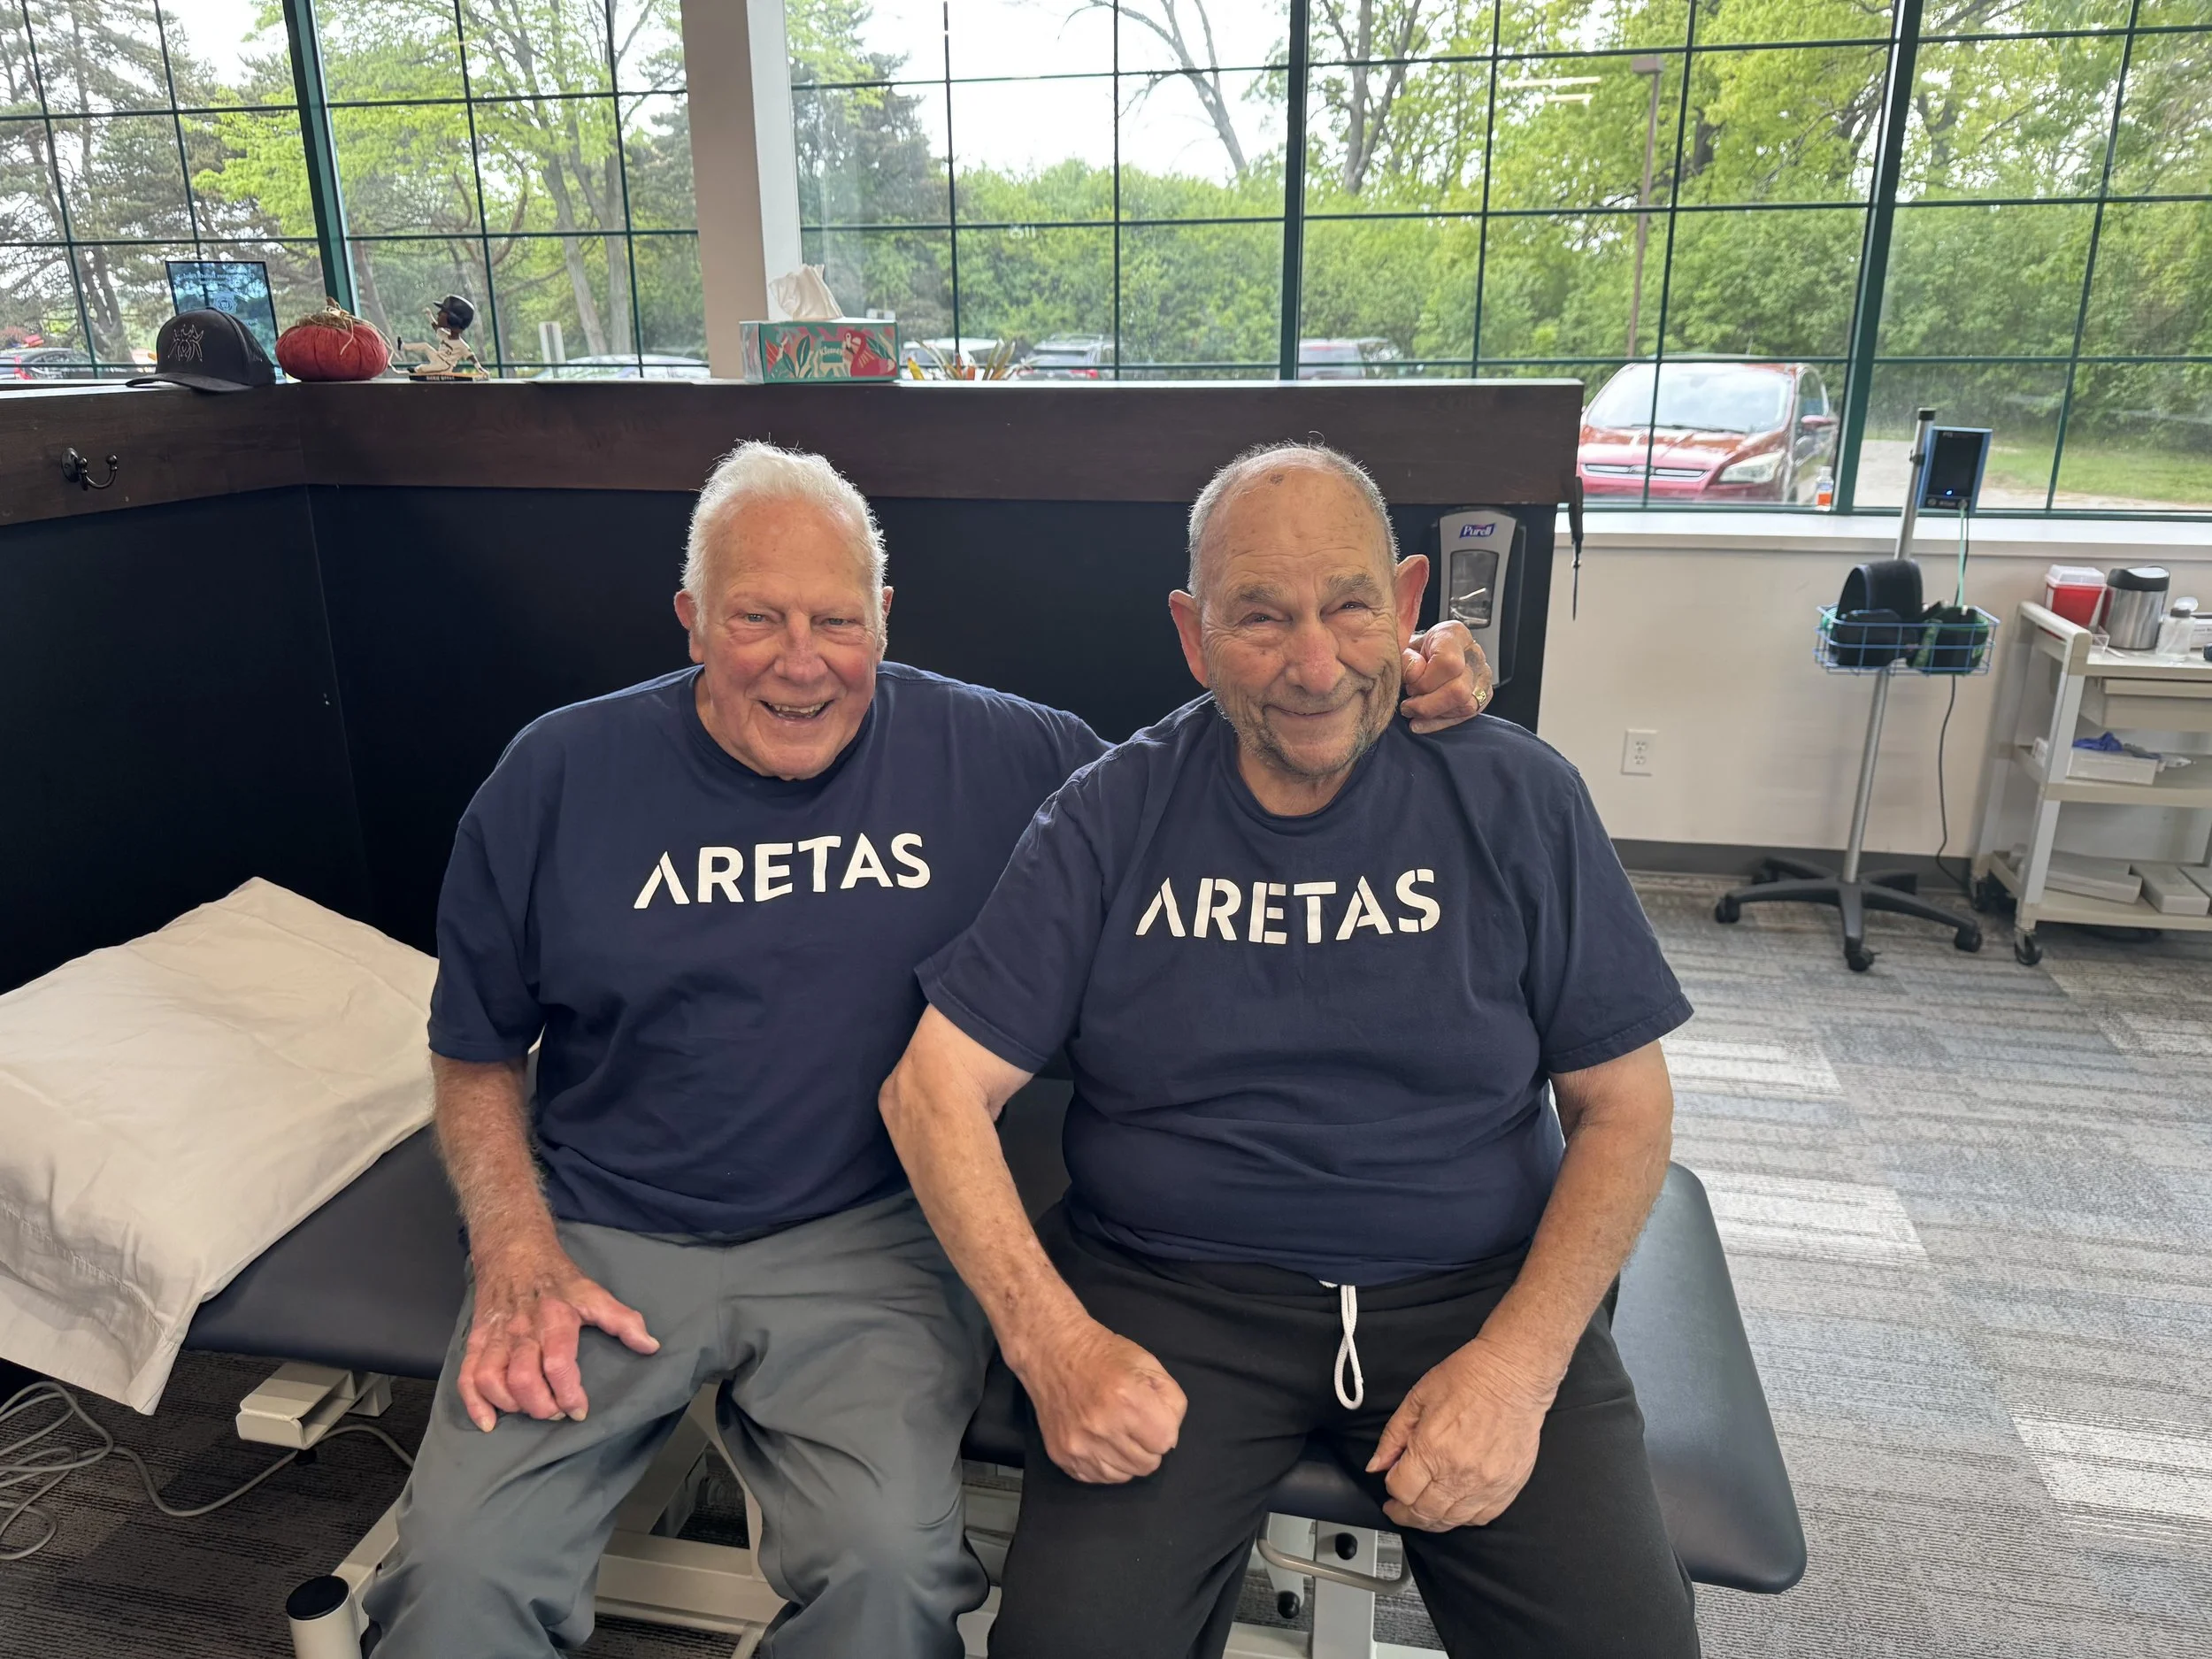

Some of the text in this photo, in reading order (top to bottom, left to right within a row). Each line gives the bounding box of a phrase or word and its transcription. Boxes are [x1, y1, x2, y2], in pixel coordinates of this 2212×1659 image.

[1463, 526, 1493, 536] Purell
[634, 833, 931, 910] ARETAS
[1136, 868, 1440, 945] ARETAS
